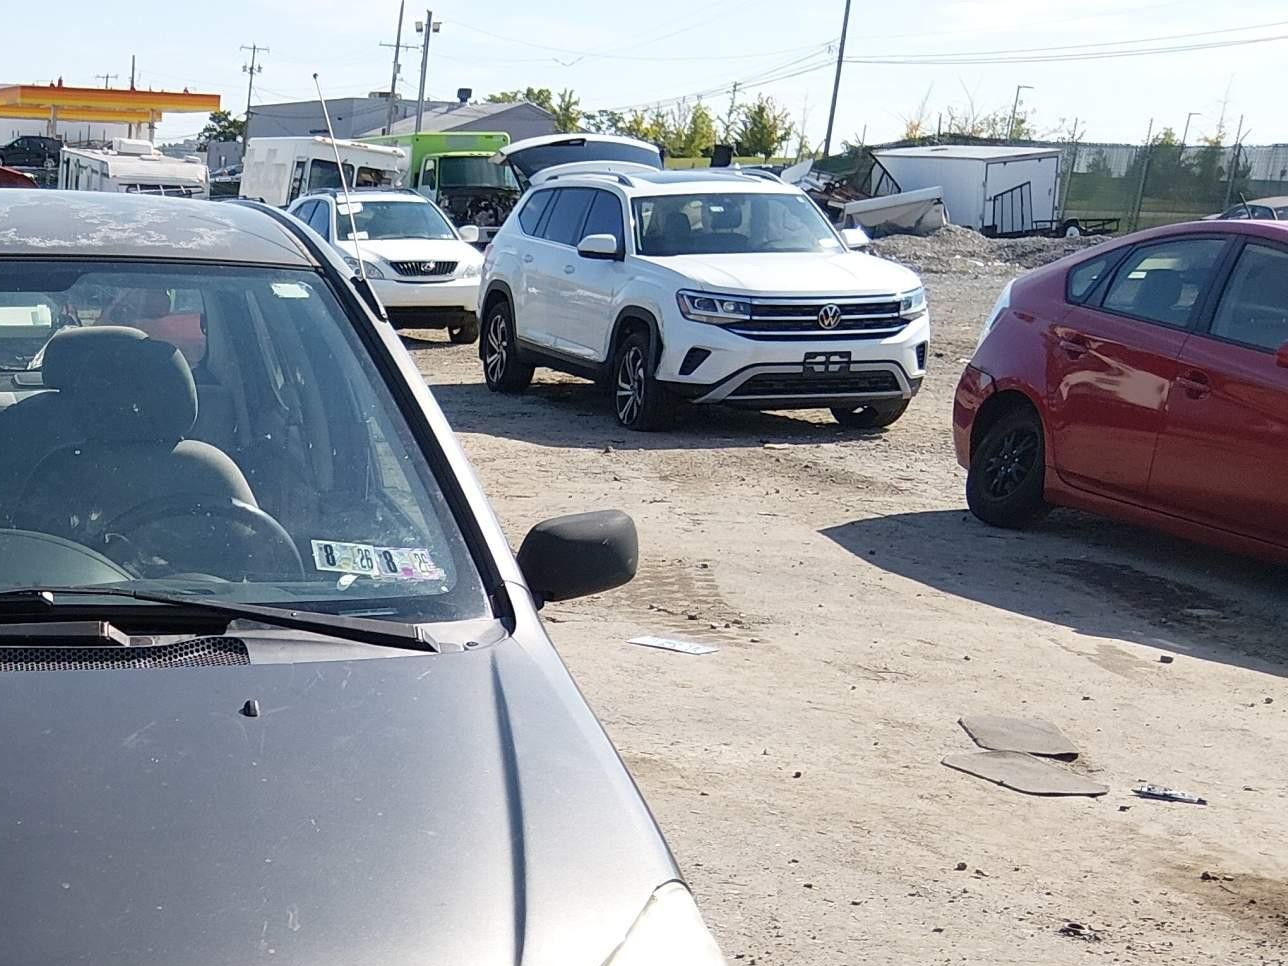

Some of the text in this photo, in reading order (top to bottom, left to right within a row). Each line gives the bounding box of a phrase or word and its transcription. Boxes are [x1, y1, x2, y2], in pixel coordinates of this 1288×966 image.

[324, 544, 374, 569] 8 26
[382, 550, 398, 573] 8
